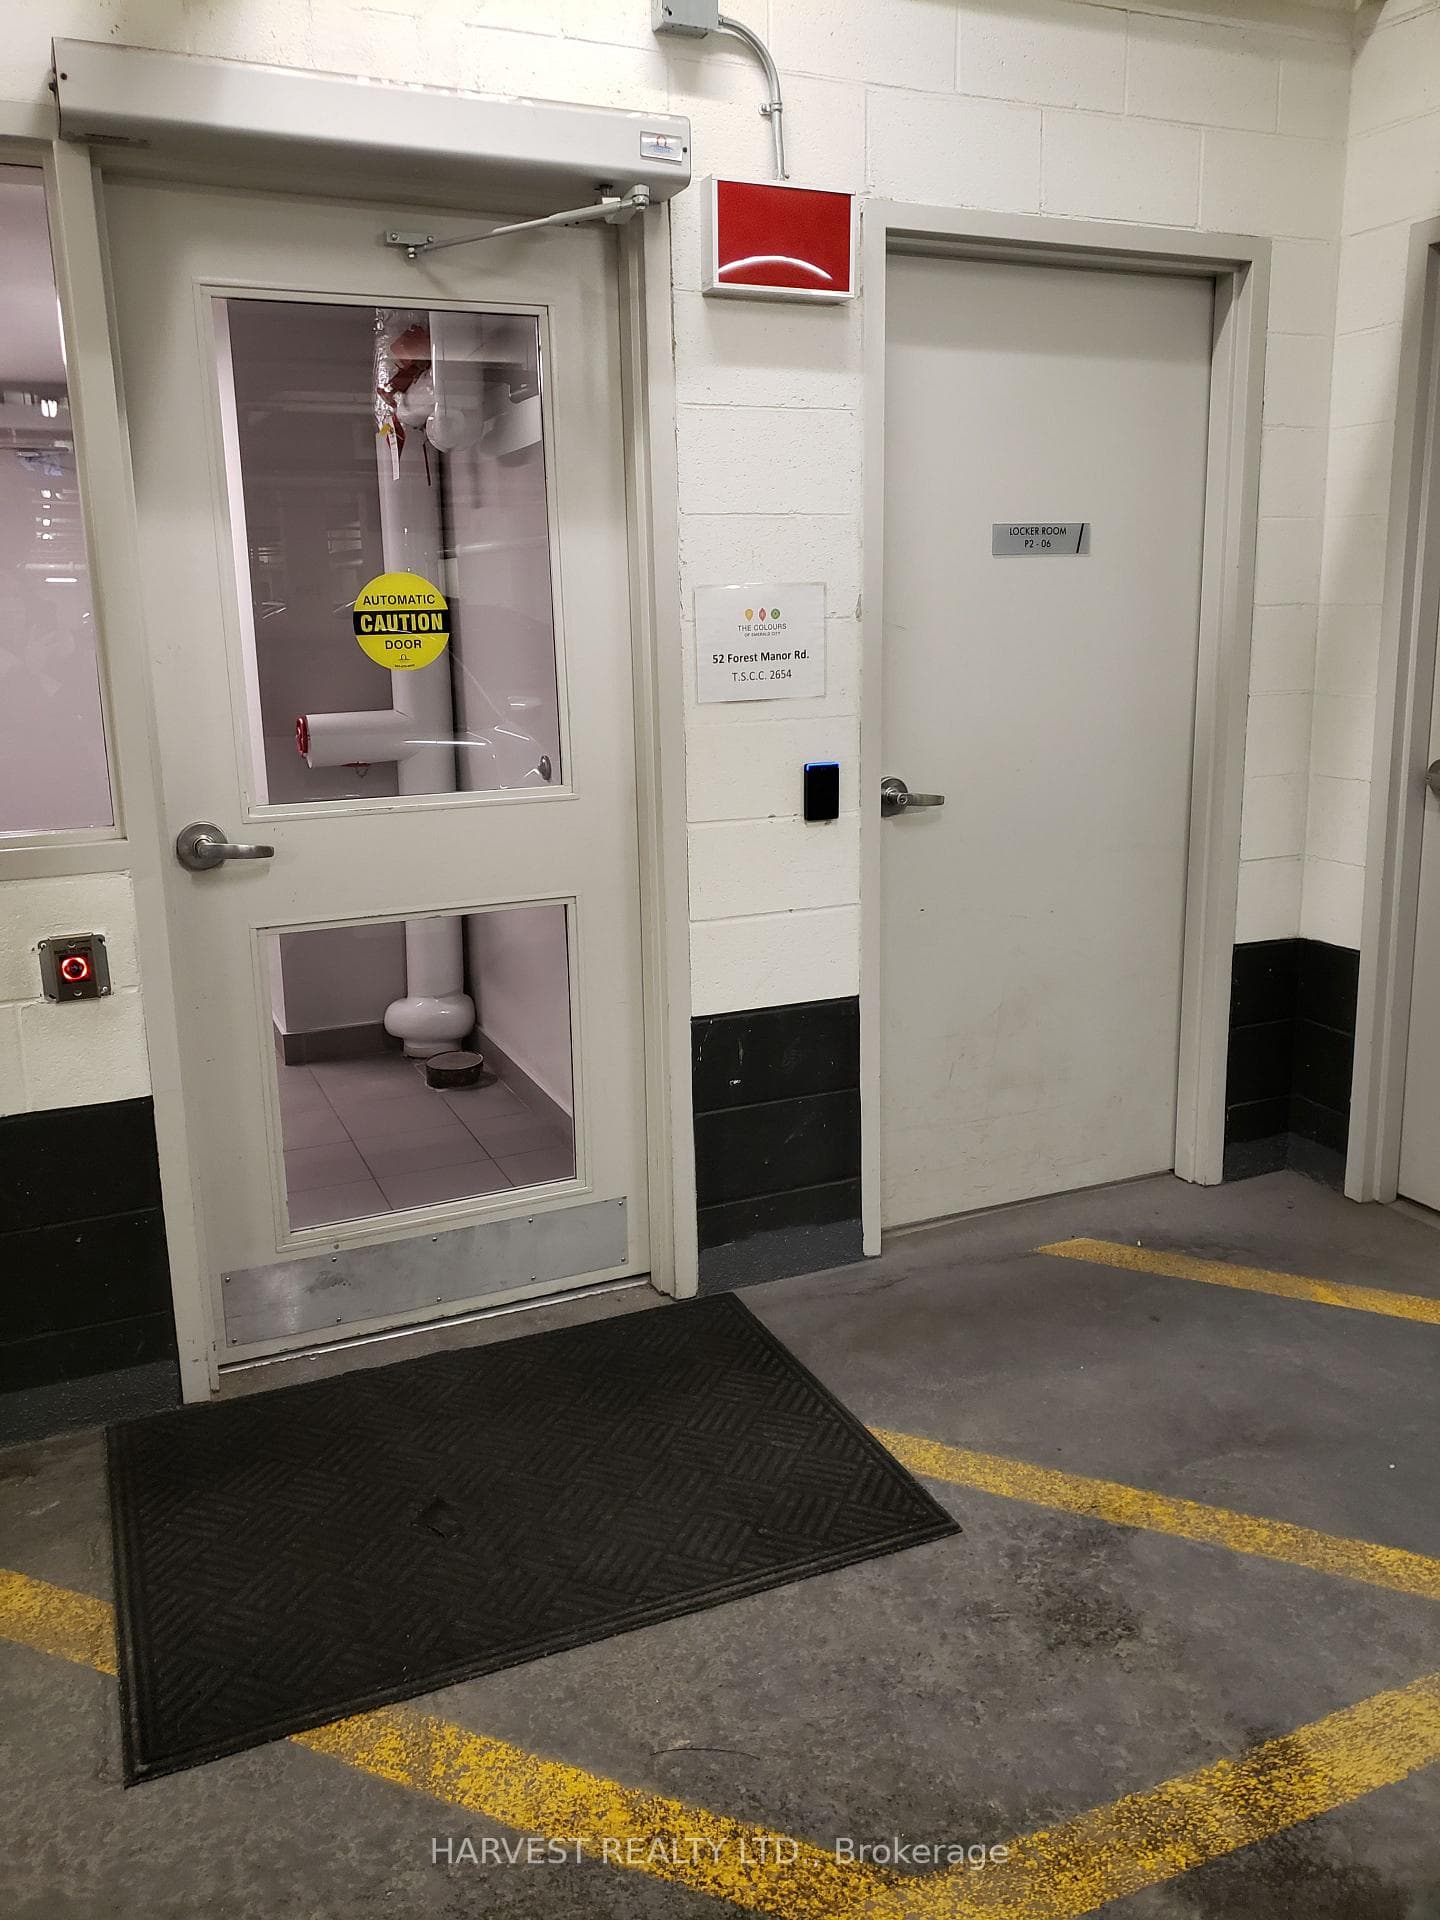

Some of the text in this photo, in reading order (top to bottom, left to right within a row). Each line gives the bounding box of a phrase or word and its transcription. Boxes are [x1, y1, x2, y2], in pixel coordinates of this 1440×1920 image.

[1009, 526, 1067, 536] LOCKER ROOM
[1024, 539, 1034, 548] P2
[1041, 539, 1051, 548] 06
[363, 594, 436, 606] AUTOMATIC
[360, 613, 443, 632] CAUTION
[738, 623, 787, 632] THE COLOURS
[385, 640, 422, 650] DOOR
[712, 649, 809, 664] 52 Forest Manor Rd.
[732, 669, 792, 682] T.S.C.C. 2654
